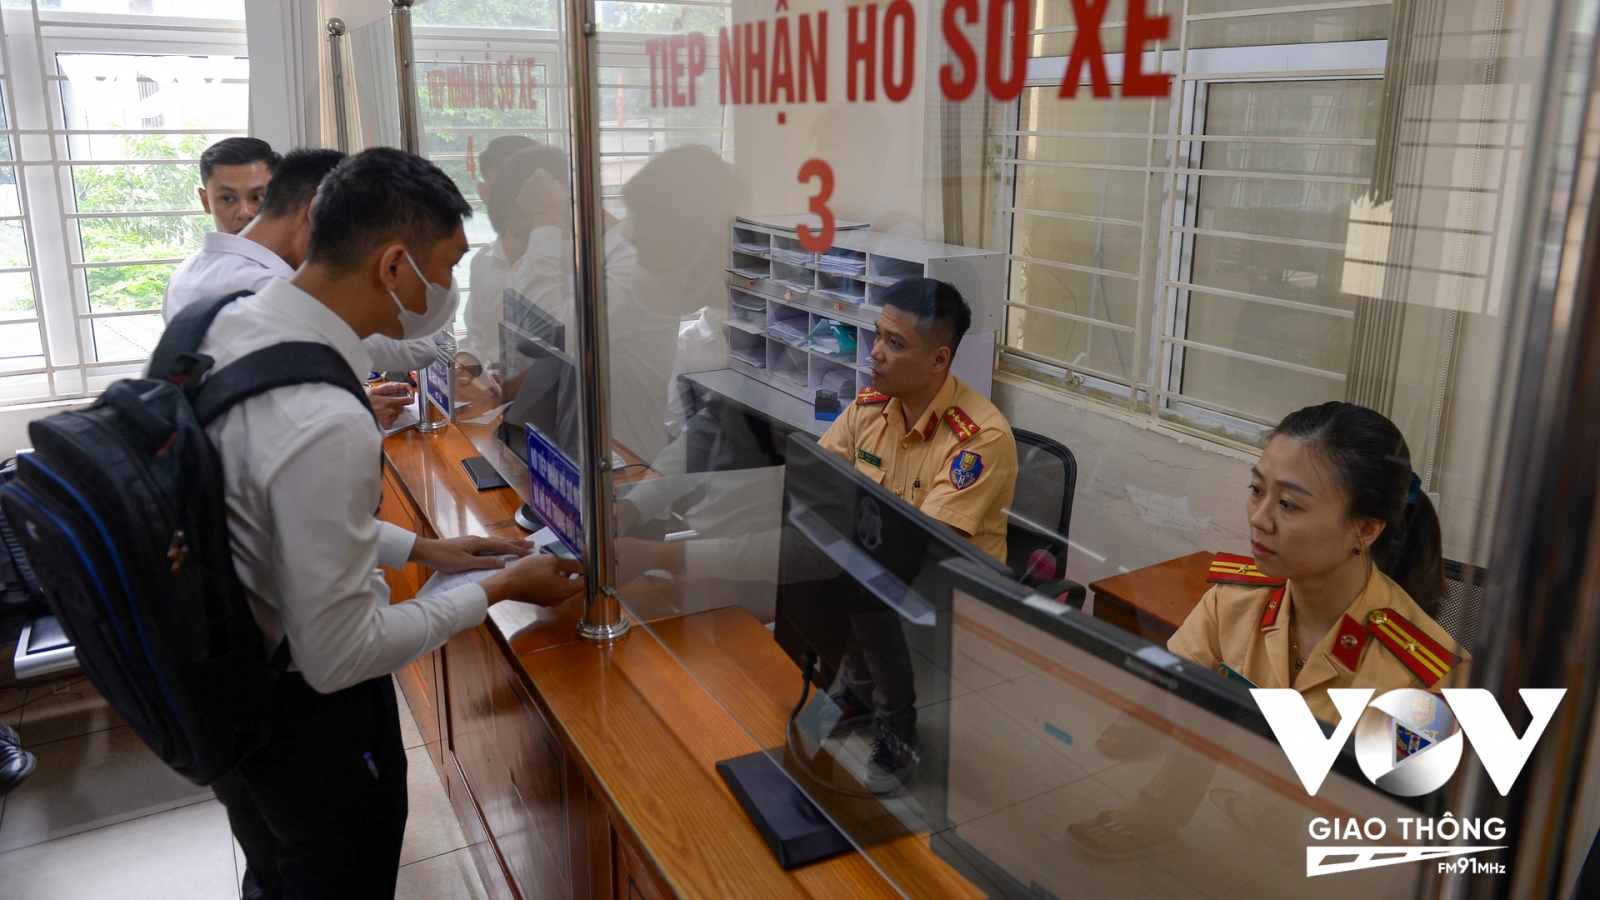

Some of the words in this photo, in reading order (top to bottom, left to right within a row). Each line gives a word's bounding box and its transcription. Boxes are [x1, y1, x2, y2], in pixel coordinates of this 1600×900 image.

[517, 57, 537, 109] XE
[645, 6, 706, 108] TIẾP
[718, 0, 828, 125] NHẬN
[1058, 0, 1172, 99] XE
[465, 136, 477, 180] 4
[797, 158, 835, 253] 3
